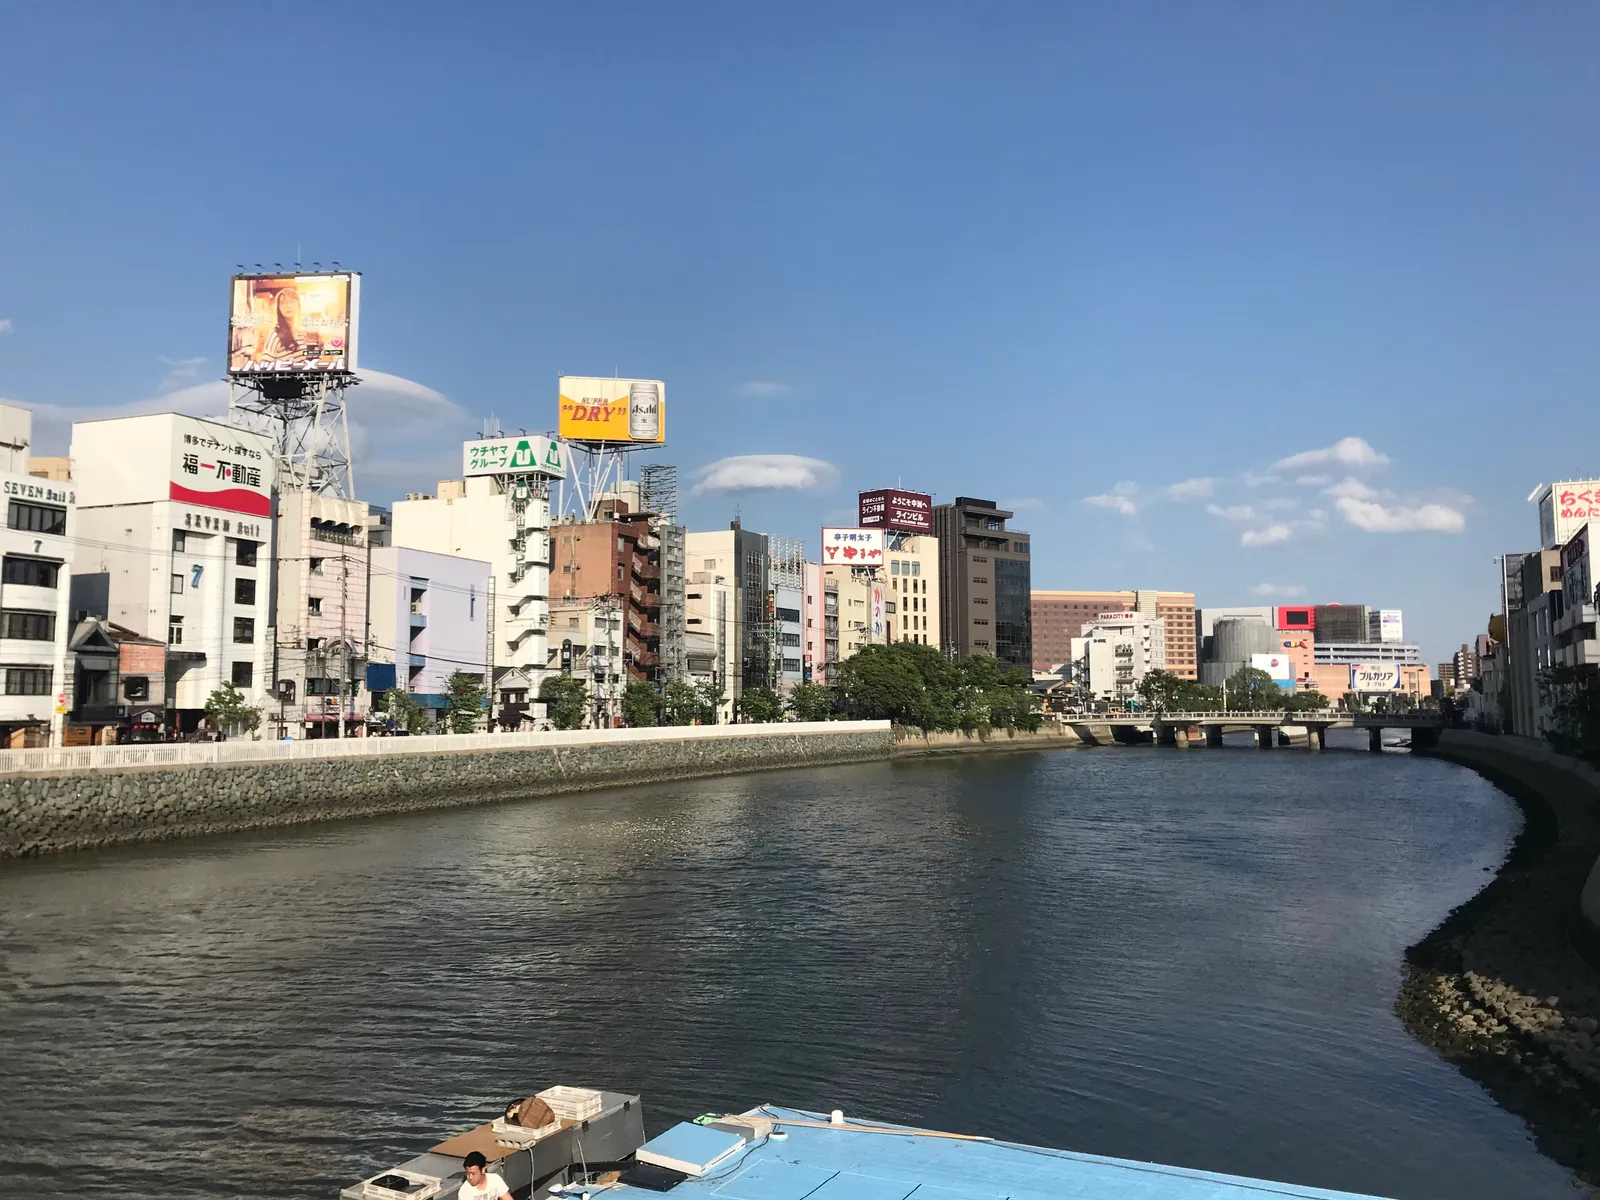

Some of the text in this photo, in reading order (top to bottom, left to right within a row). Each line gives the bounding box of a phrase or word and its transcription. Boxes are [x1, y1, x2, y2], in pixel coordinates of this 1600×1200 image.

[632, 403, 657, 415] Asahi
[183, 433, 262, 460] 博多でテナント探すなら
[470, 445, 509, 458] ウチヤマ
[182, 453, 261, 488] 福一不動産
[470, 456, 509, 470] グループ
[4, 480, 44, 499] SEVEN
[891, 496, 928, 509] ようこそ中洲へ
[185, 513, 230, 533] SEVEN
[896, 510, 924, 522] ラインビル
[842, 545, 882, 560] やまや
[191, 563, 204, 589] 7
